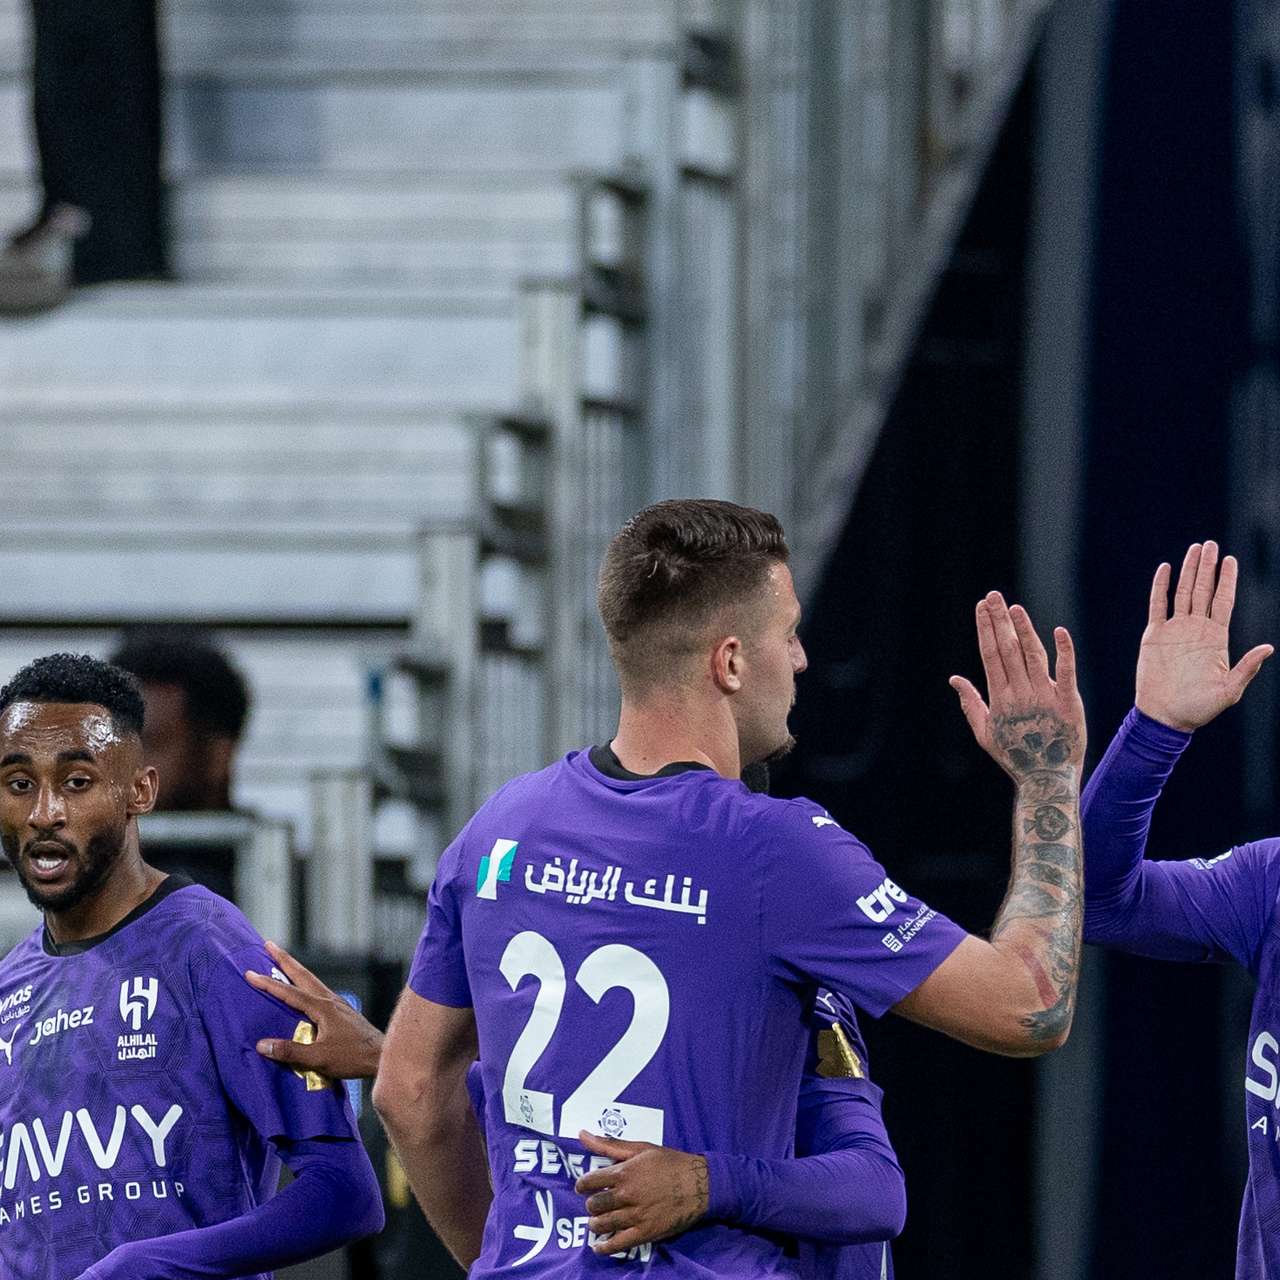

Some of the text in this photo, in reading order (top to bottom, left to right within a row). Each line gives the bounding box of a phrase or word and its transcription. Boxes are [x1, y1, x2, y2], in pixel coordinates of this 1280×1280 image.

[524, 857, 709, 925] بنك الرياض
[118, 1046, 156, 1060] الهلال
[499, 930, 670, 1146] 22
[0, 1180, 185, 1225] AMES GROUP
